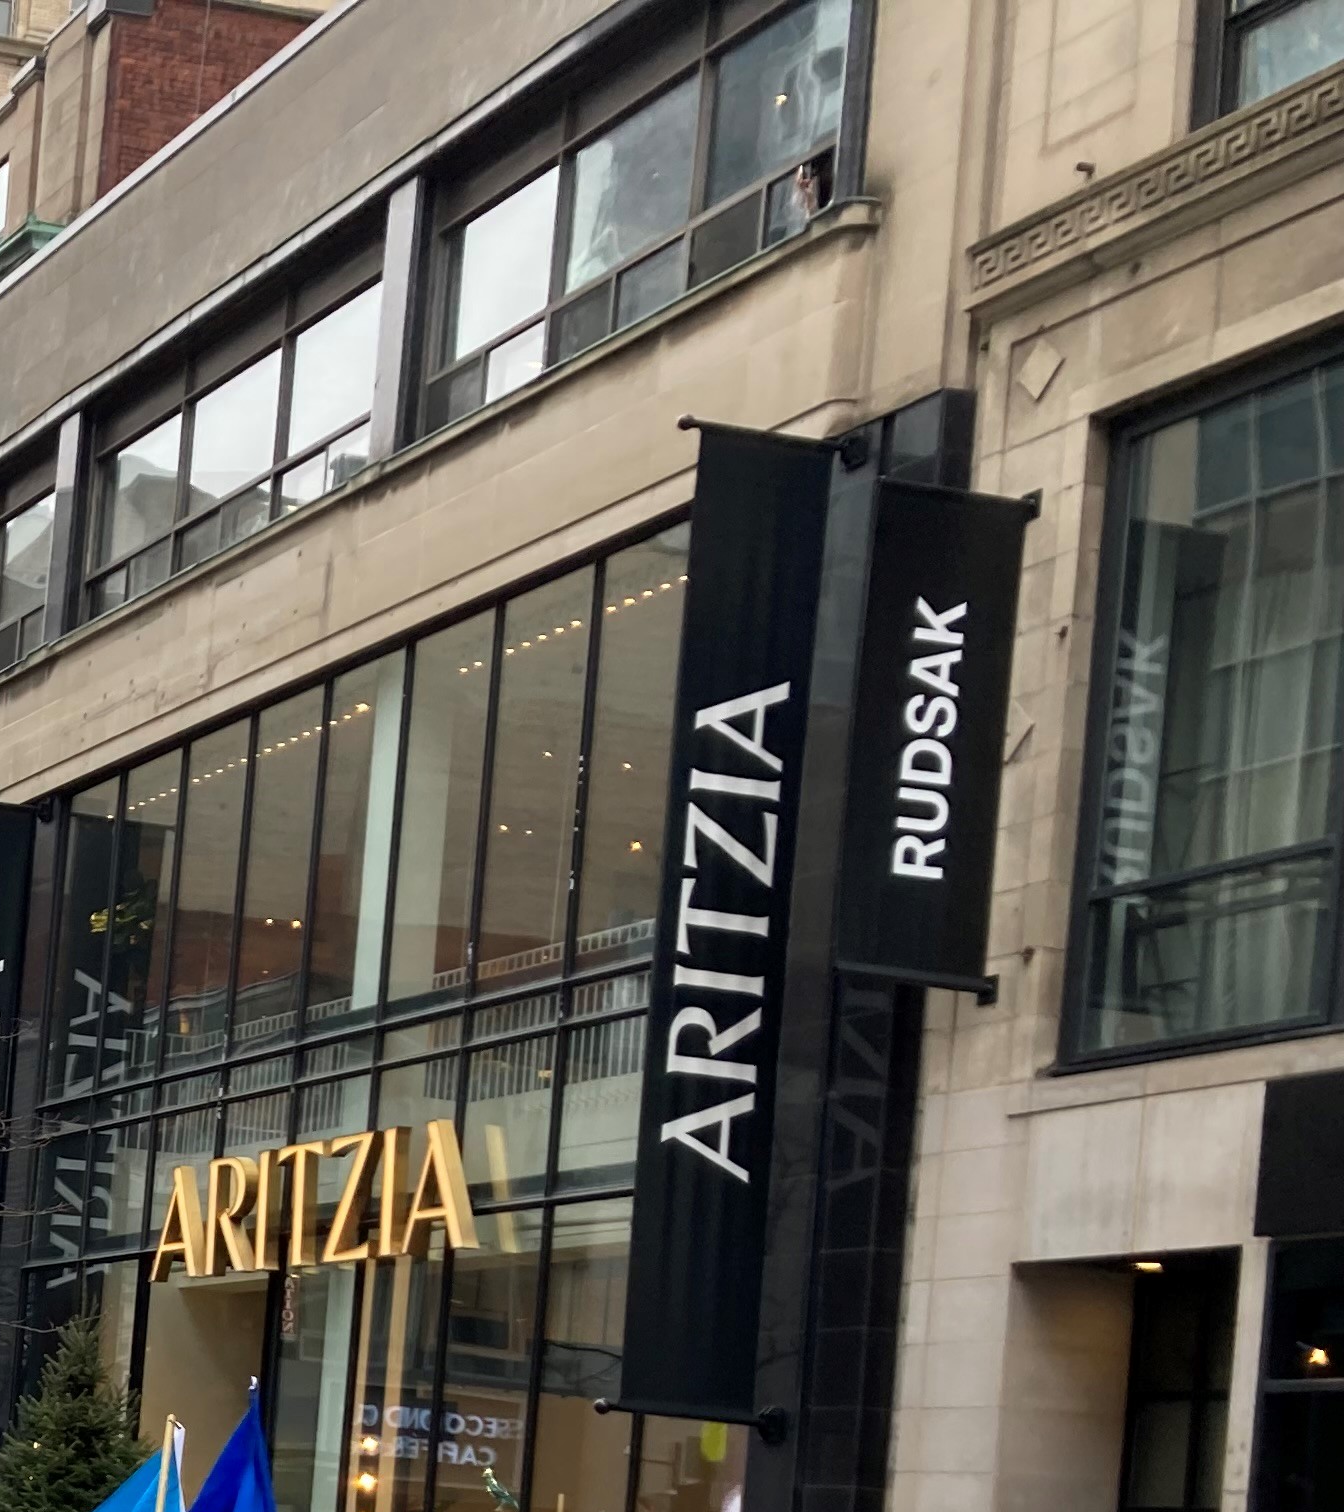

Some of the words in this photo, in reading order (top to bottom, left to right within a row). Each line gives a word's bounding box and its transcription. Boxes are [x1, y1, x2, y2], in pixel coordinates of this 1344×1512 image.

[892, 596, 969, 881] RUDSAK
[660, 681, 791, 1184] ARITZIA
[149, 1119, 479, 1283] ARITZIA
